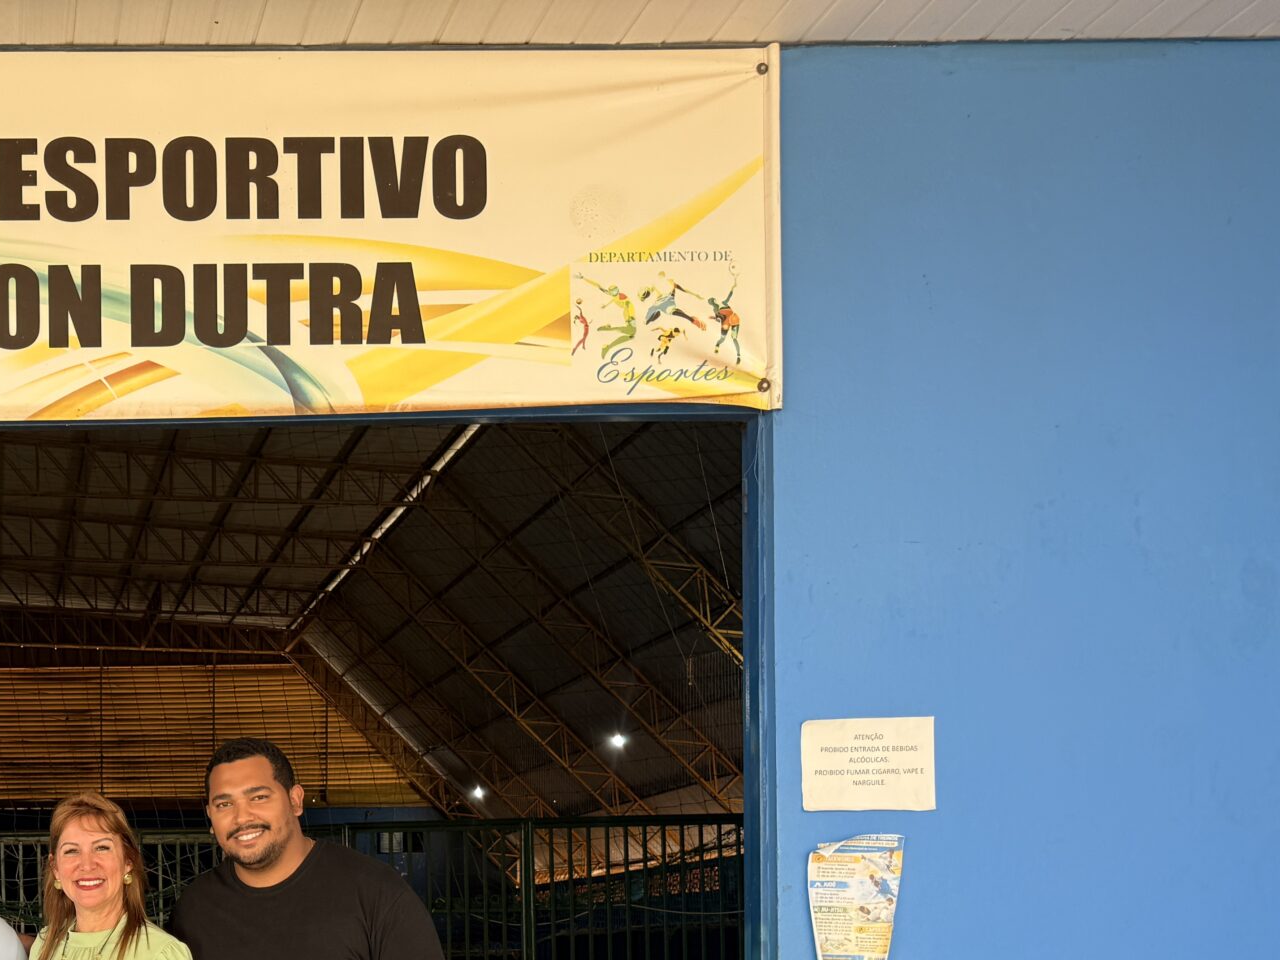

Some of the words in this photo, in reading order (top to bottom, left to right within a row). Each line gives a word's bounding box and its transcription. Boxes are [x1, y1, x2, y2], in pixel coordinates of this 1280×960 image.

[588, 251, 709, 263] DEPARTAMENTO
[713, 250, 732, 262] DE
[130, 262, 426, 348] DUTRA
[597, 347, 734, 396] Esportes
[853, 732, 884, 741] ATENÇÃO
[850, 745, 880, 753] ENTRADA
[891, 744, 918, 752] BEBIDAS
[846, 768, 870, 776] FUMAR
[871, 767, 901, 776] CIGARRO,
[902, 767, 919, 775] VAPE
